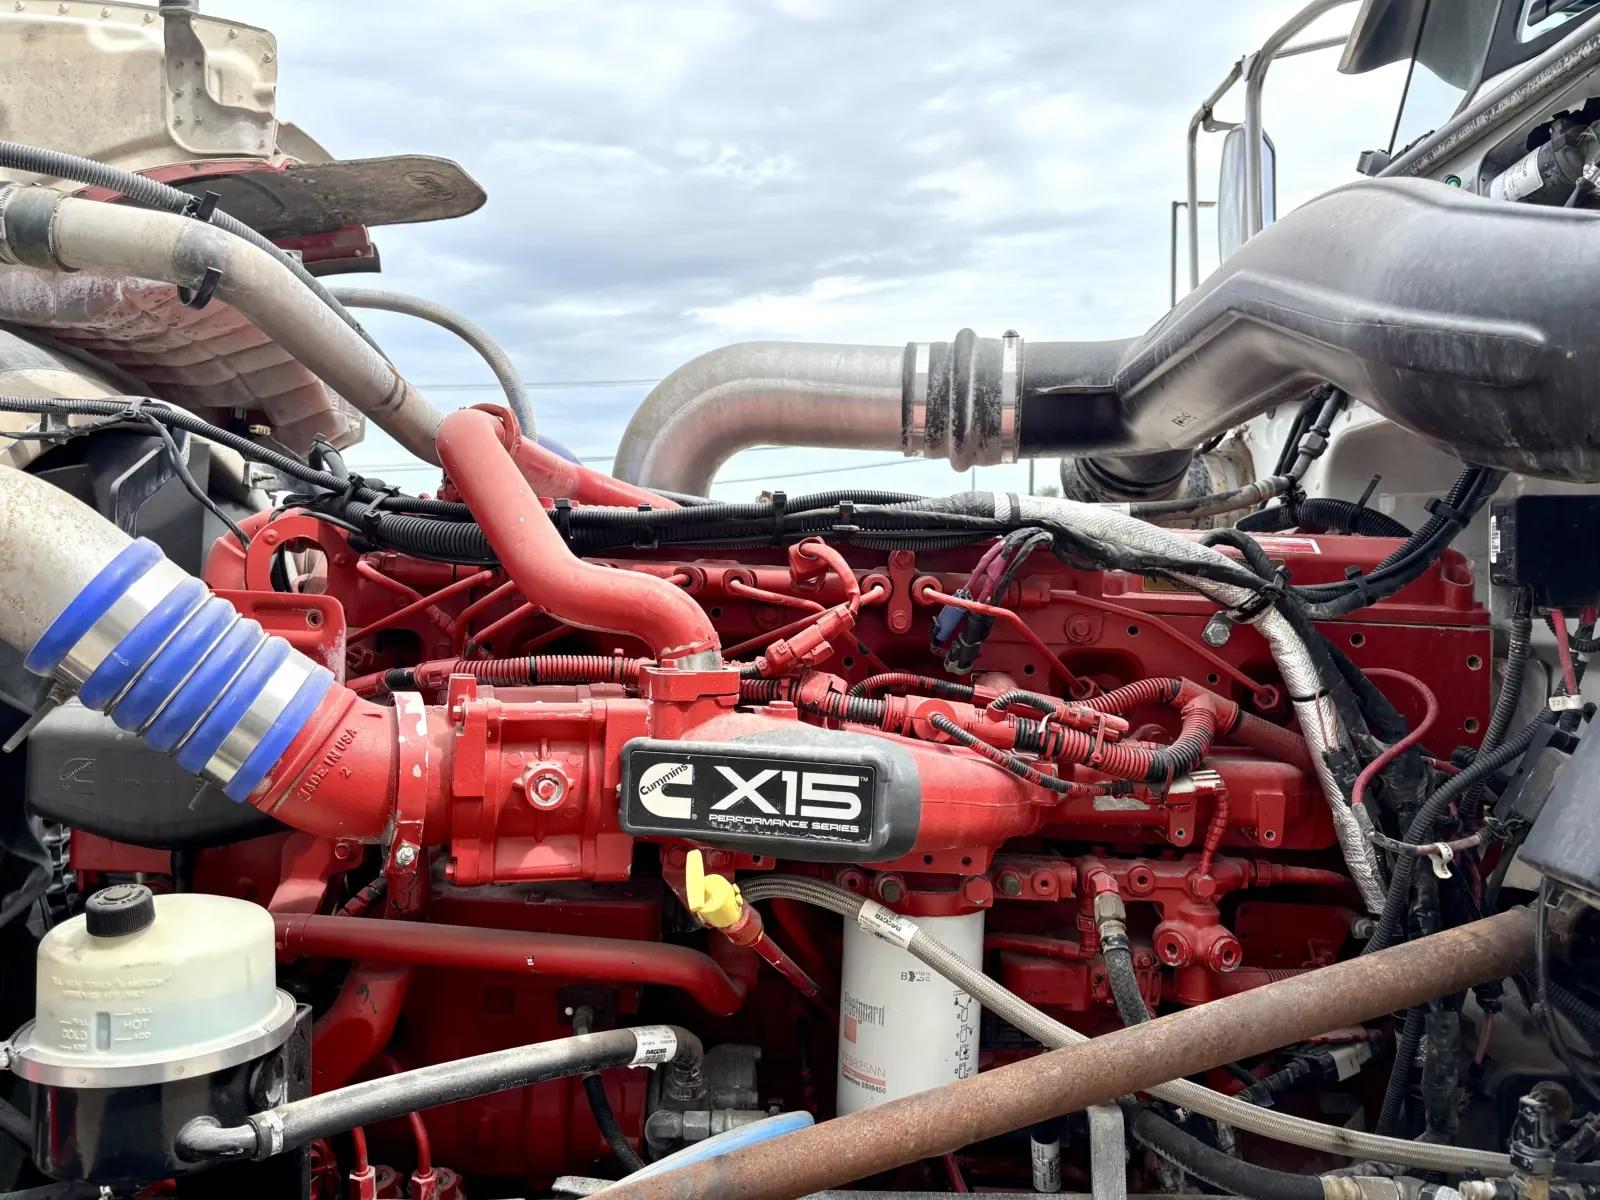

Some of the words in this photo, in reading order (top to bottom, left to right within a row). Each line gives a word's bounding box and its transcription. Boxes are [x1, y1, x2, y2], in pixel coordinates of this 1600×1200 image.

[323, 750, 342, 767] IN
[335, 728, 357, 751] USA
[340, 766, 353, 780] 2
[639, 763, 689, 796] Cummins
[709, 766, 862, 821] X15
[709, 813, 809, 829] PERFORMANCE
[811, 822, 860, 833] SERIES
[123, 1018, 151, 1030] HOT
[62, 1028, 88, 1041] COLD
